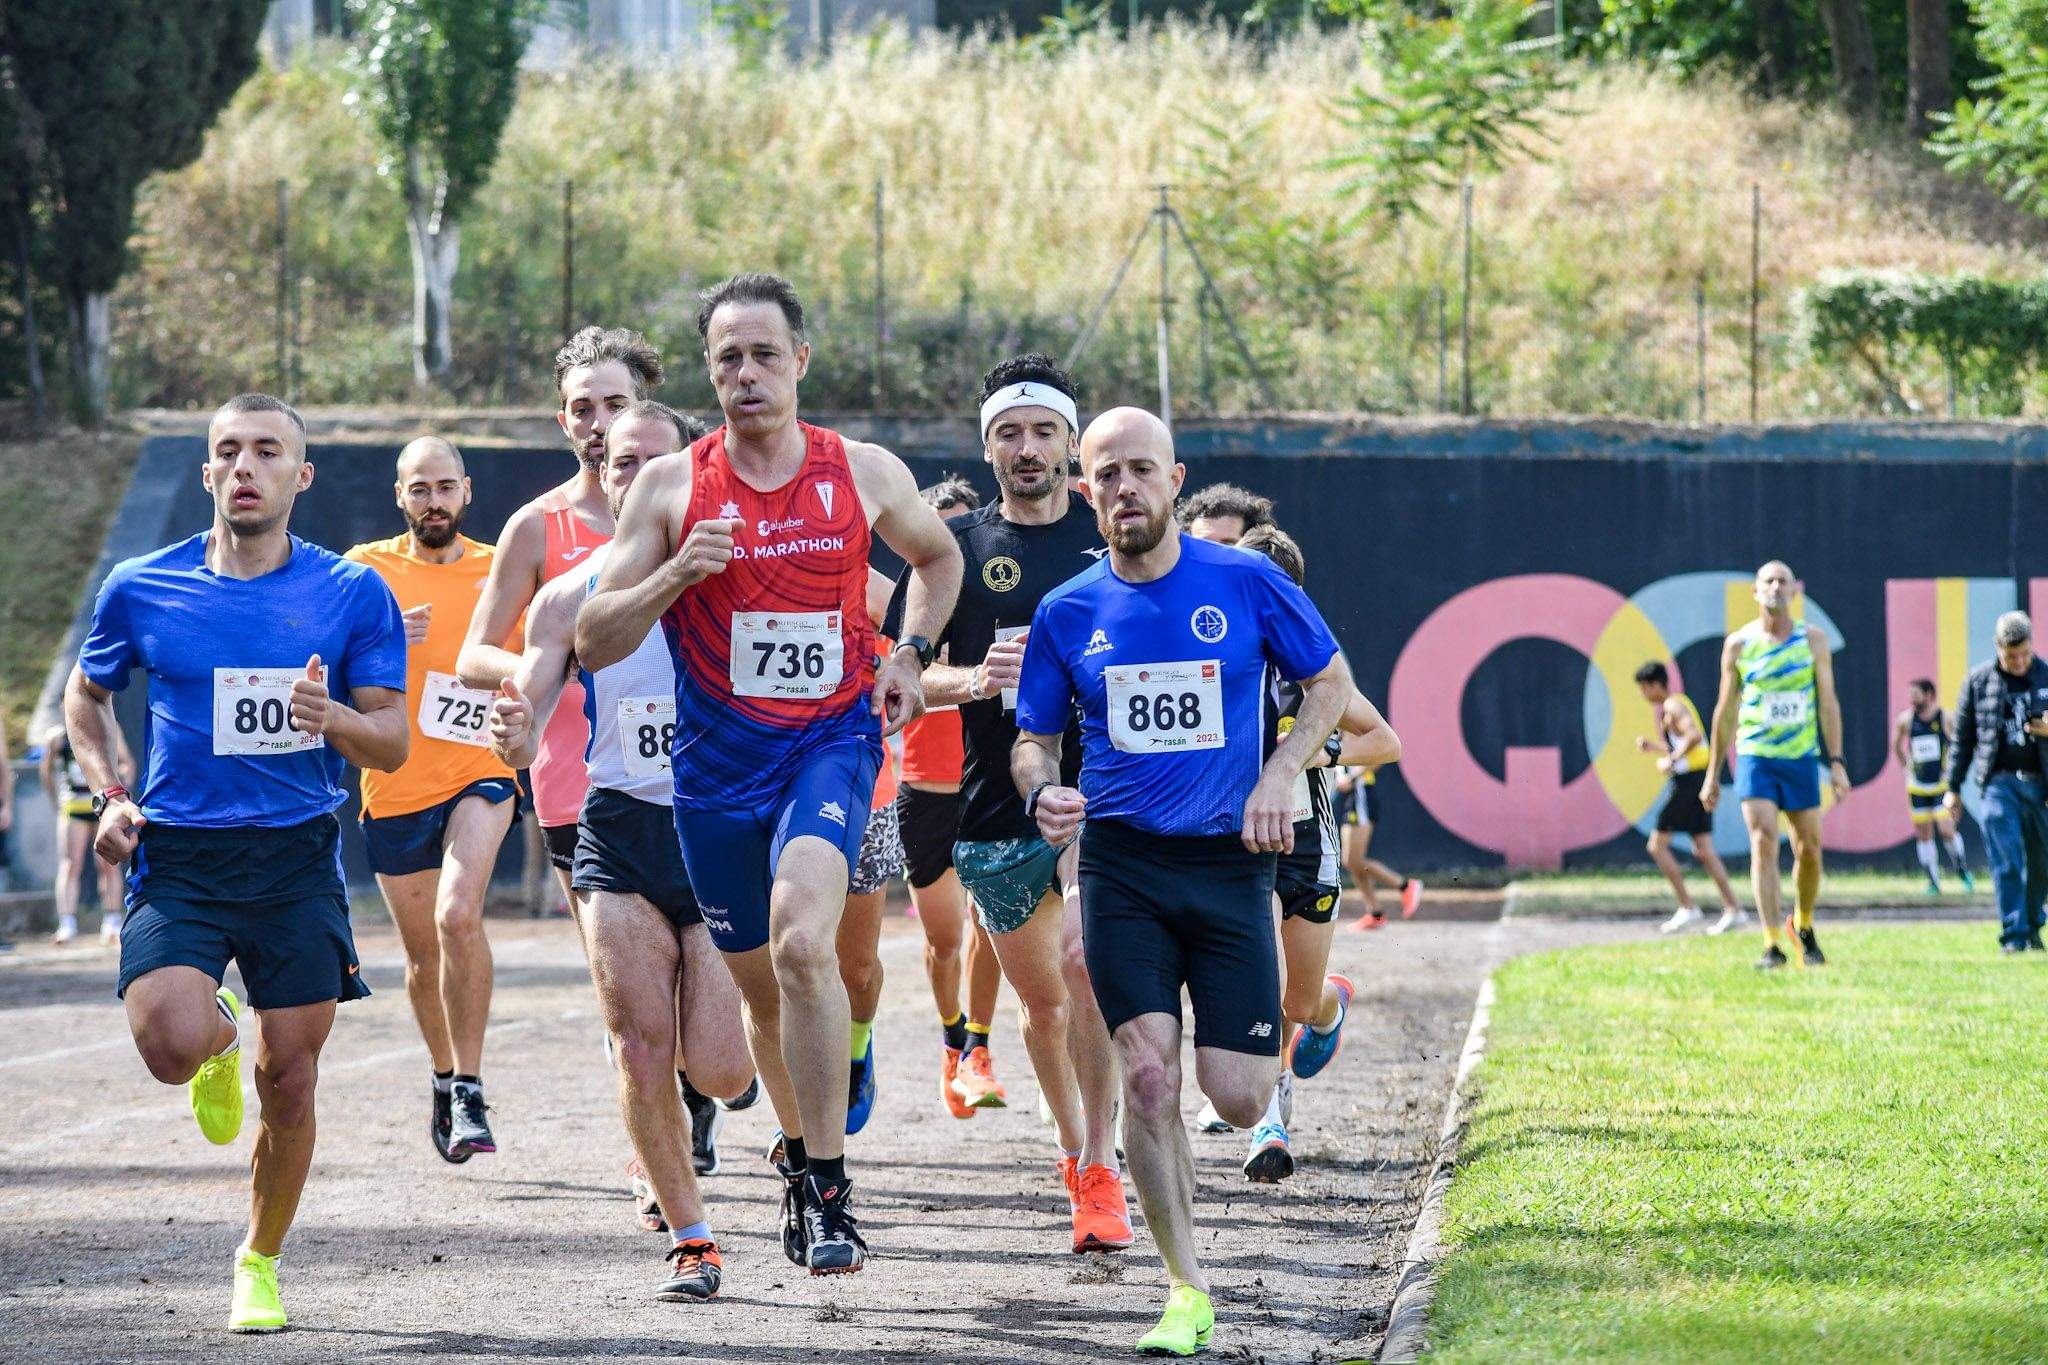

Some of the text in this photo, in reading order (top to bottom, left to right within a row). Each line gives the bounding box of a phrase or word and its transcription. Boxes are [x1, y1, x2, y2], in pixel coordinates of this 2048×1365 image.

[754, 537, 844, 559] MARATHON
[752, 641, 825, 679] 736
[437, 696, 487, 730] 725
[1128, 692, 1202, 732] 868
[1196, 733, 1218, 743] 2023
[705, 916, 733, 932] DM
